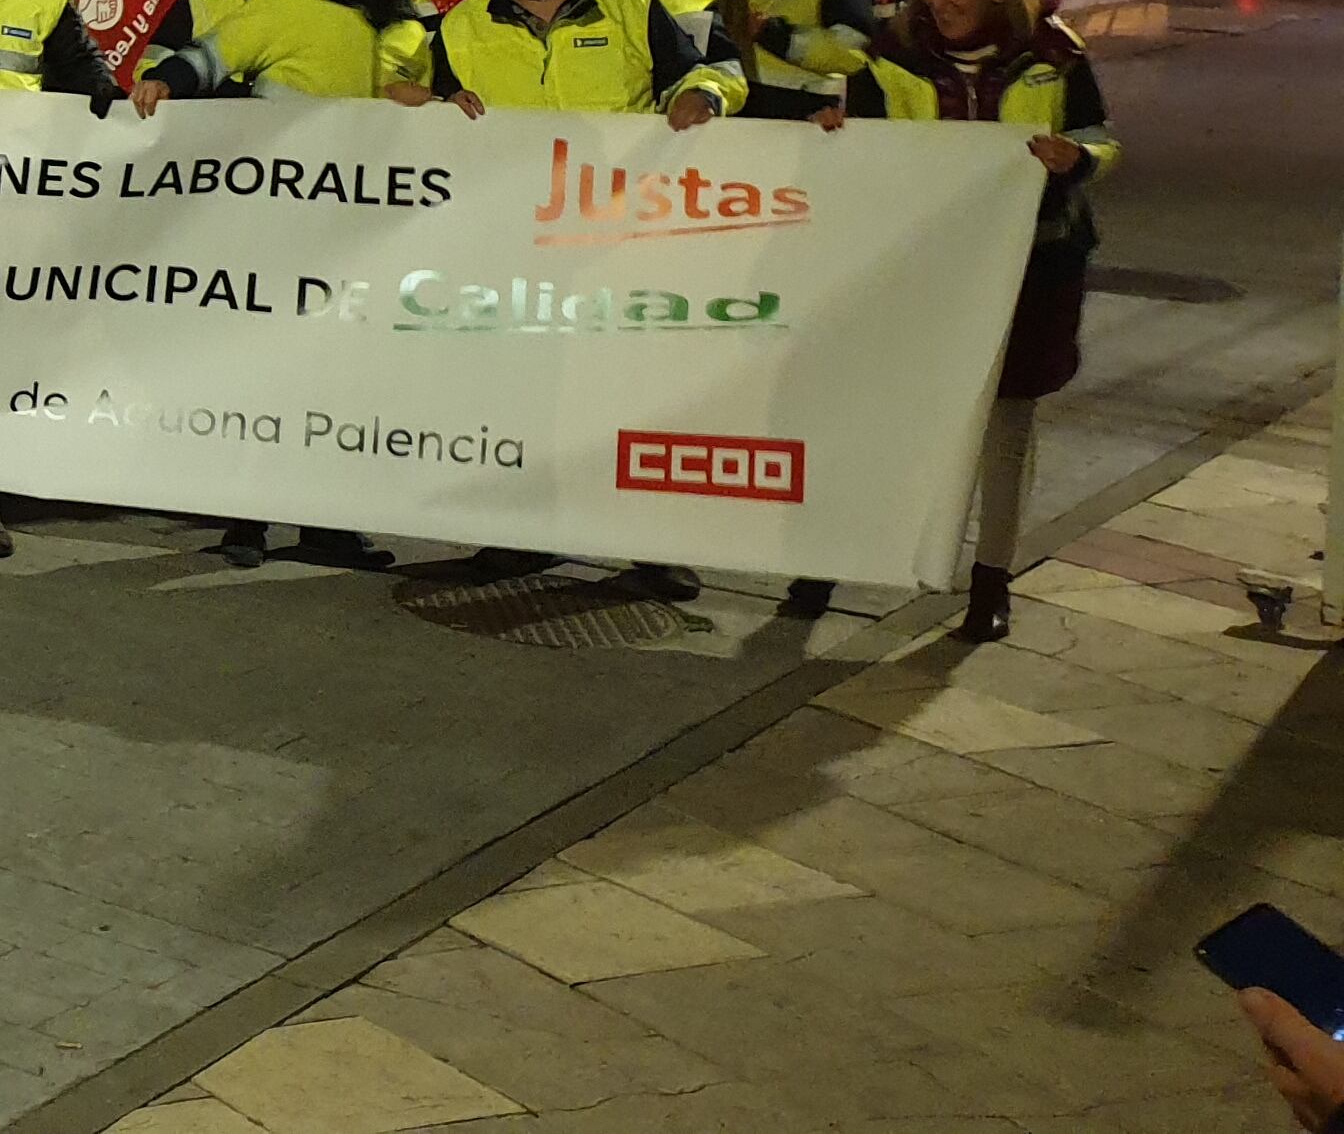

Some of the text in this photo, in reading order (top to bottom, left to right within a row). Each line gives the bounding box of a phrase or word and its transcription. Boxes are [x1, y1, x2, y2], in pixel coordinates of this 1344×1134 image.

[119, 156, 452, 208] LABORALES
[534, 138, 810, 222] Justas
[296, 277, 370, 324] DE
[399, 269, 781, 323] Calidad
[9, 381, 70, 421] de
[304, 410, 525, 469] Palencia
[628, 442, 793, 492] CCOO
